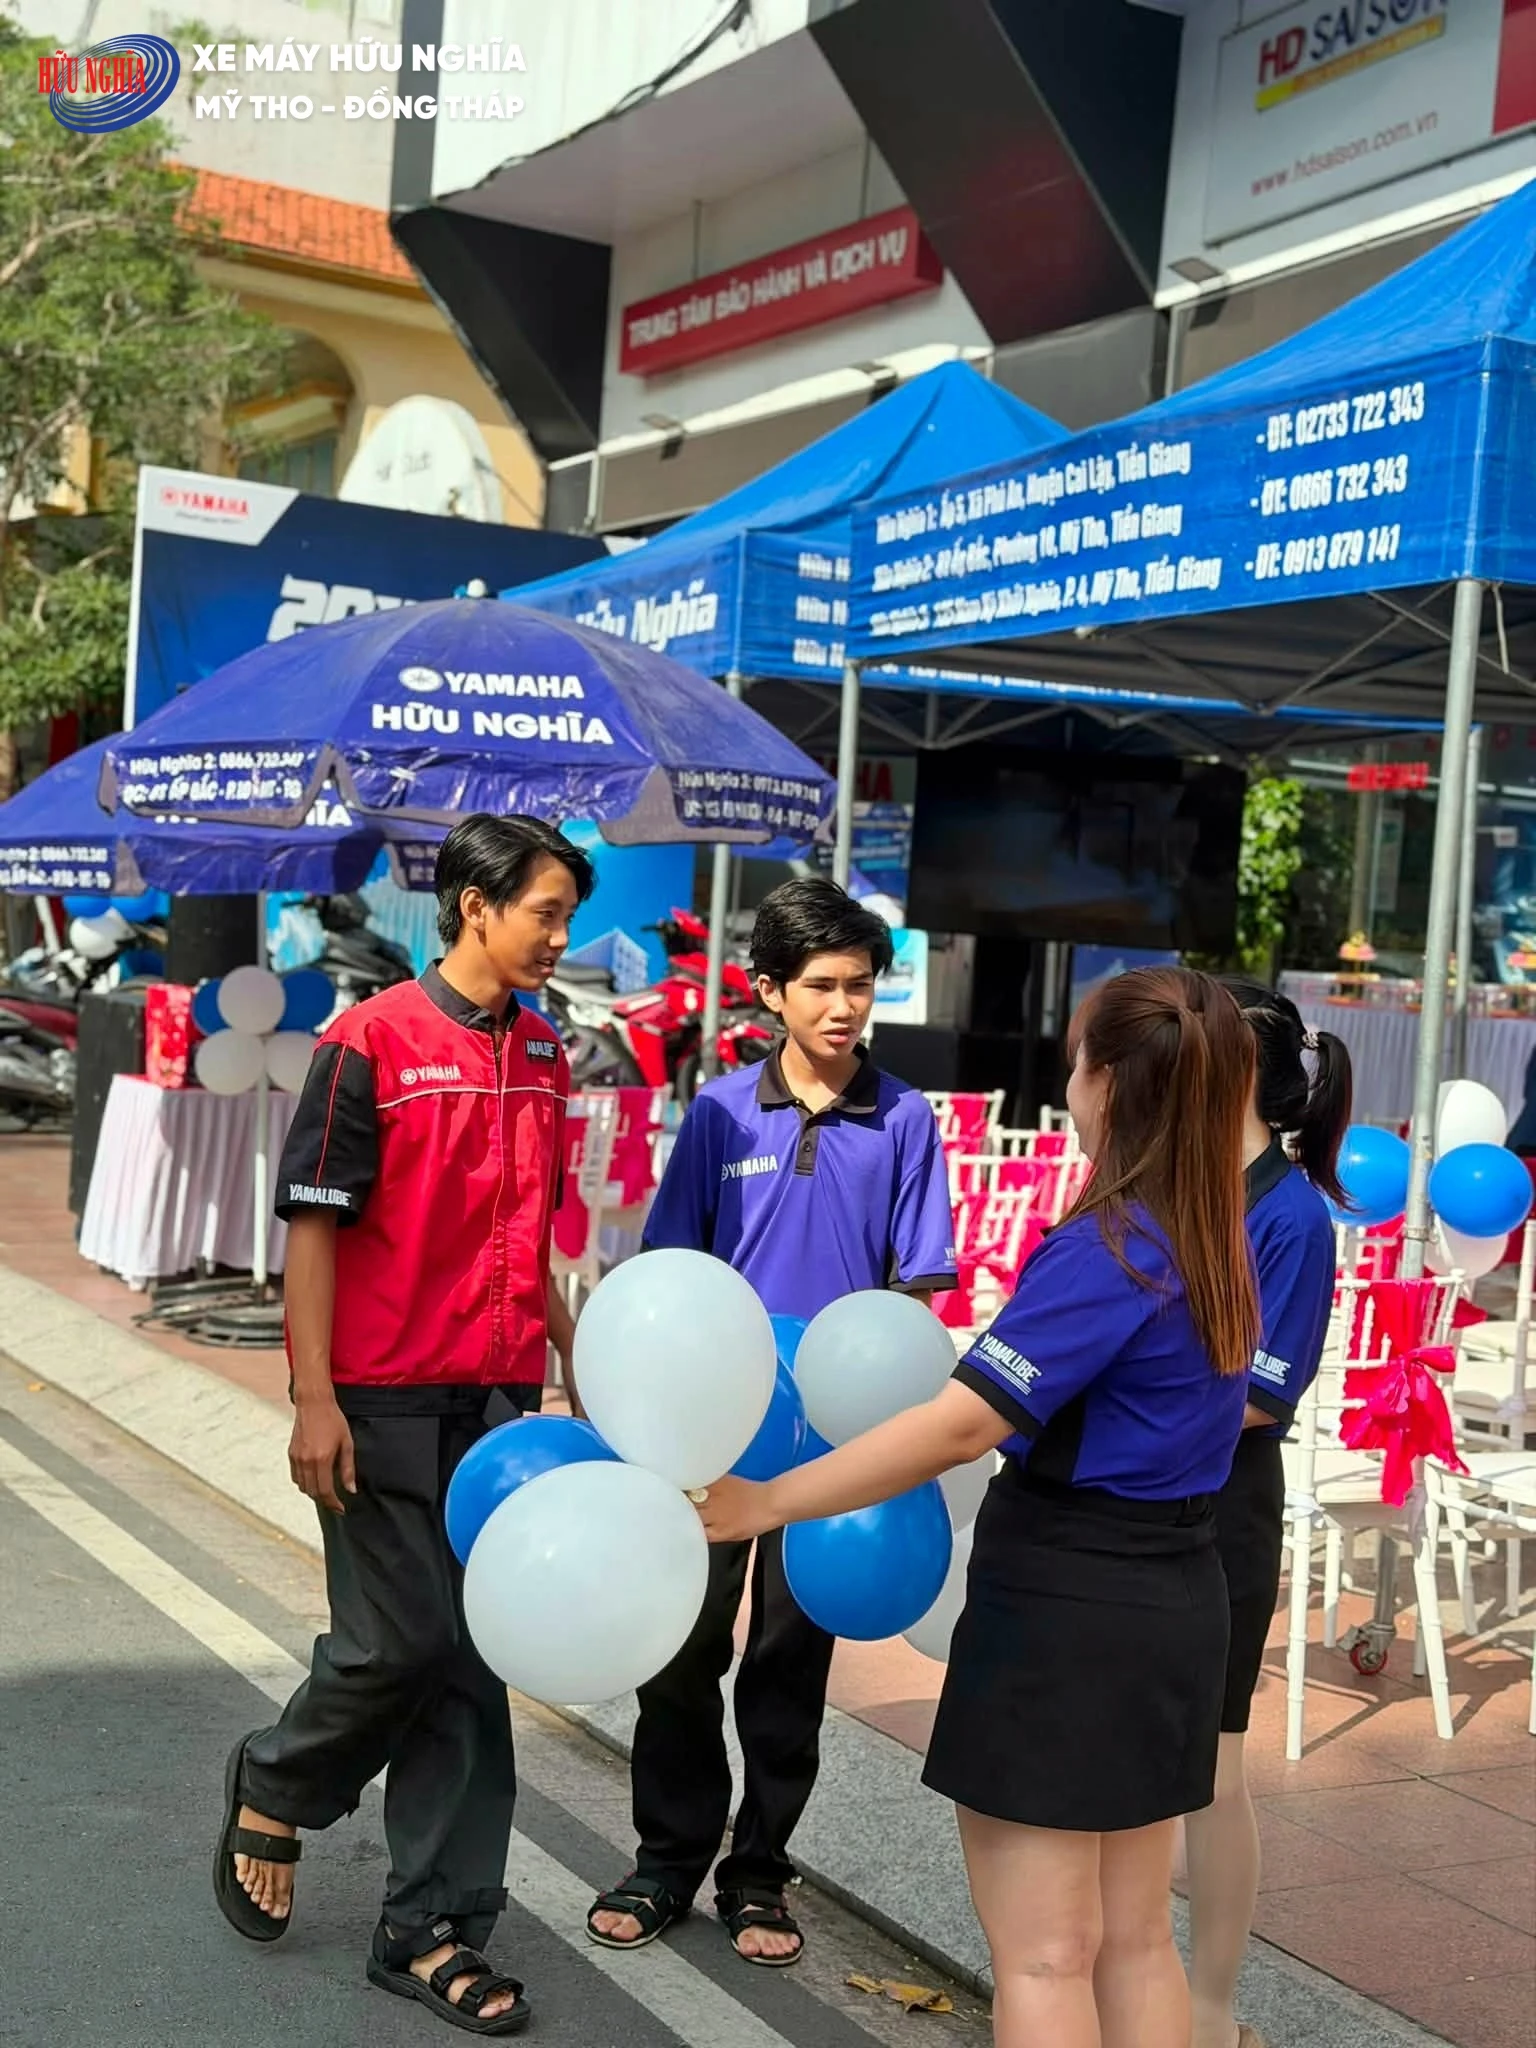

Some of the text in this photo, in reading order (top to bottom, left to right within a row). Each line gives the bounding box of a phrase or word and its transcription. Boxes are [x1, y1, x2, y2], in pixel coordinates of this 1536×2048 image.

[1258, 27, 1306, 85] HD
[831, 237, 876, 283] DỊCH
[878, 227, 908, 267] VỤ
[1295, 400, 1350, 446] 02733
[1352, 390, 1386, 434] 722
[1388, 381, 1425, 426] 343
[1148, 441, 1191, 477] Giang
[1289, 468, 1333, 511] 0866
[1335, 462, 1371, 502] 732
[1371, 454, 1409, 497] 343
[181, 491, 249, 517] YAMAHA
[1141, 503, 1183, 538] Giang
[1282, 535, 1328, 577] 0913
[1327, 528, 1365, 569] 879
[1367, 523, 1401, 564] 141
[1176, 556, 1222, 591] Giang
[631, 578, 719, 653] Nghĩa
[444, 671, 585, 699] YAMAHA
[372, 701, 614, 745] HỮU NGHĨA
[416, 1064, 462, 1081] YAMAHA
[728, 1154, 778, 1179] YAMAHA
[289, 1183, 352, 1207] YAMALUBE
[979, 1332, 1042, 1384] YAMALUBE
